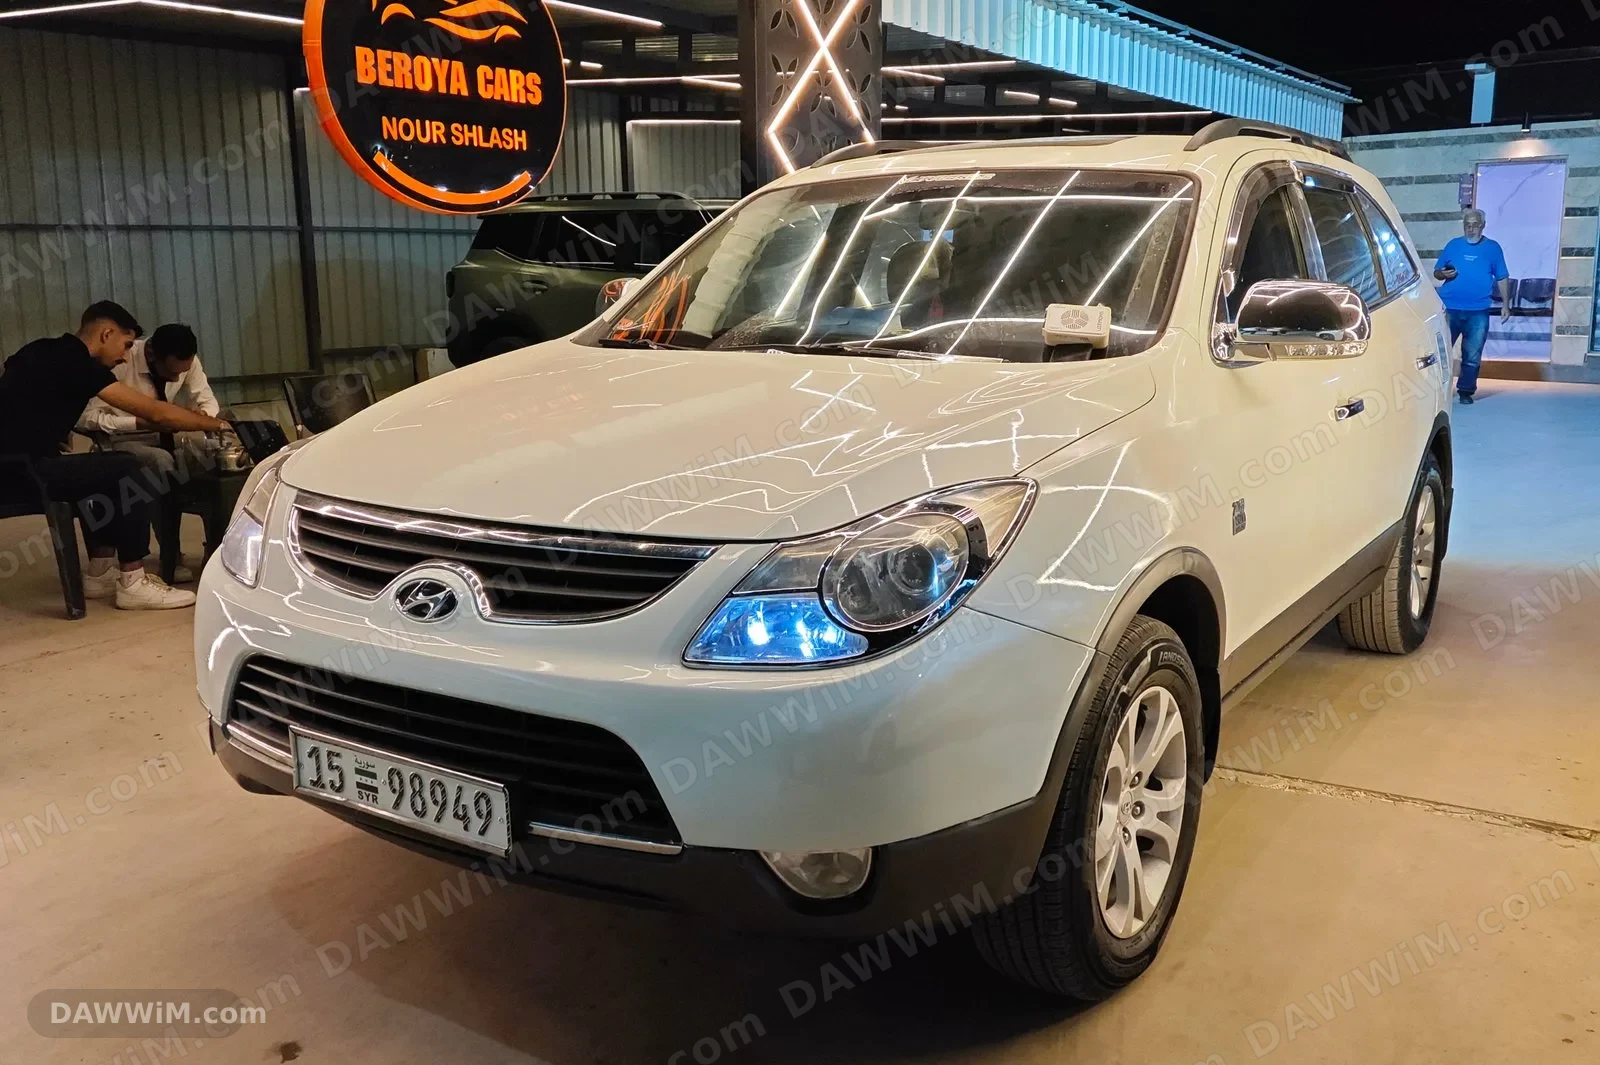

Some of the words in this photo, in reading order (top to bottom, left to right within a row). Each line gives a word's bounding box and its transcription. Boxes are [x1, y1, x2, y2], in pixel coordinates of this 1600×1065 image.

[355, 46, 469, 96] BEROYA
[476, 65, 542, 105] CARS
[382, 115, 446, 144] NOUR
[450, 122, 527, 151] SHLASH
[307, 744, 345, 793] 15
[387, 766, 493, 836] 98949
[357, 790, 379, 805] SYR
